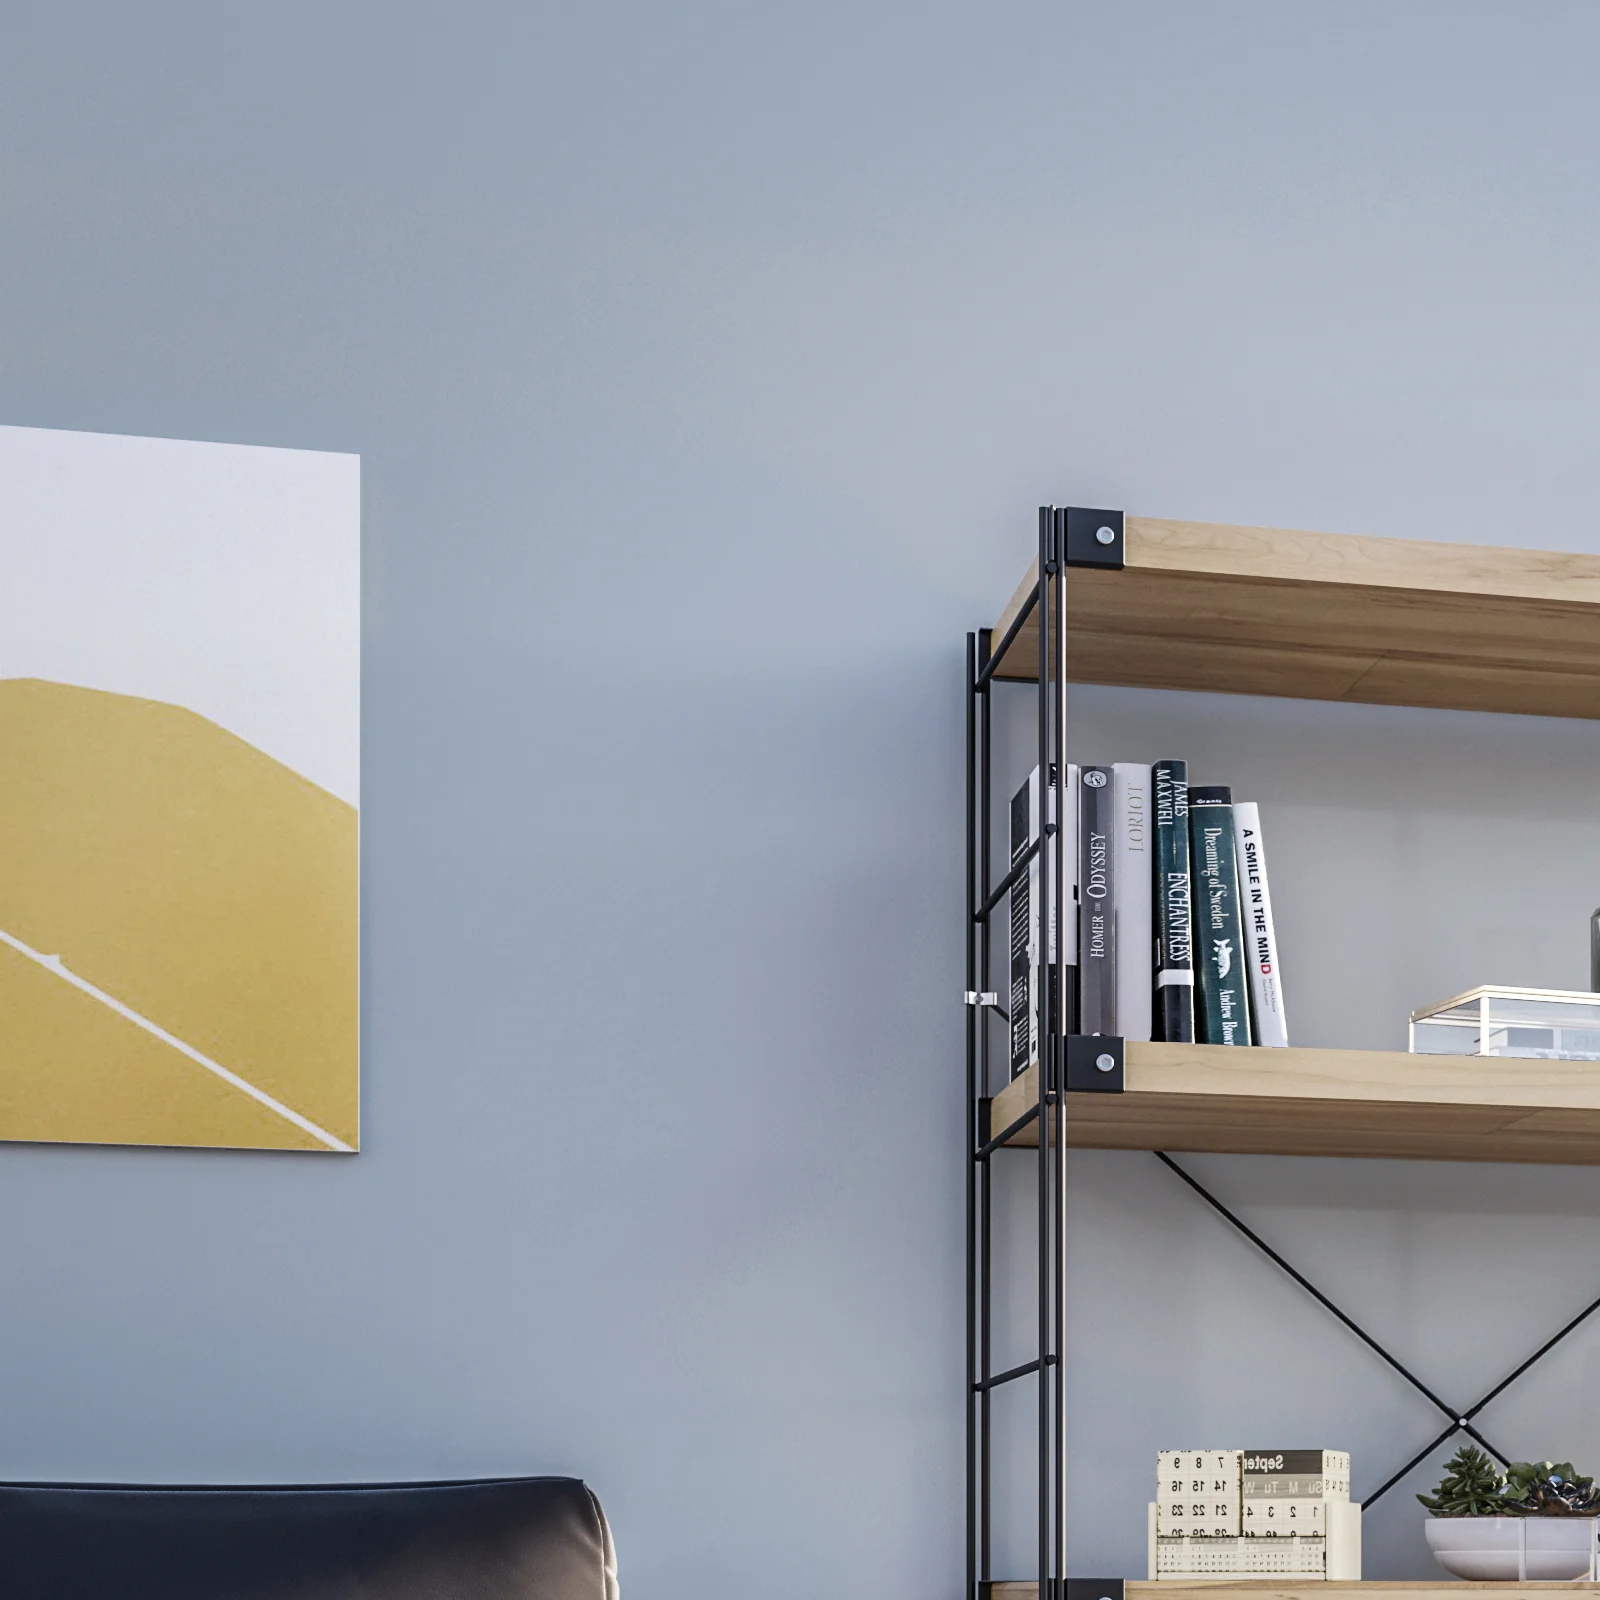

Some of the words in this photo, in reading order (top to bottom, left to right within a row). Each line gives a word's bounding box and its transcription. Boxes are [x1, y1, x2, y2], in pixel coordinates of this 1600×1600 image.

[1128, 782, 1144, 852] LORIOT
[1169, 780, 1189, 817] JAMES
[1200, 827, 1224, 877] Dreaming
[1242, 828, 1254, 838] A
[1086, 831, 1107, 898] ODYSSEY
[1244, 842, 1260, 885] SMILE
[1208, 878, 1227, 890] of
[1250, 888, 1262, 903] IN
[1167, 872, 1191, 962] ENCHANTRESS
[1209, 889, 1229, 929] Sweden
[1253, 907, 1267, 933] THE
[1090, 915, 1105, 958] HOMER
[1256, 937, 1272, 975] MIND
[1219, 988, 1236, 1019] Andrew
